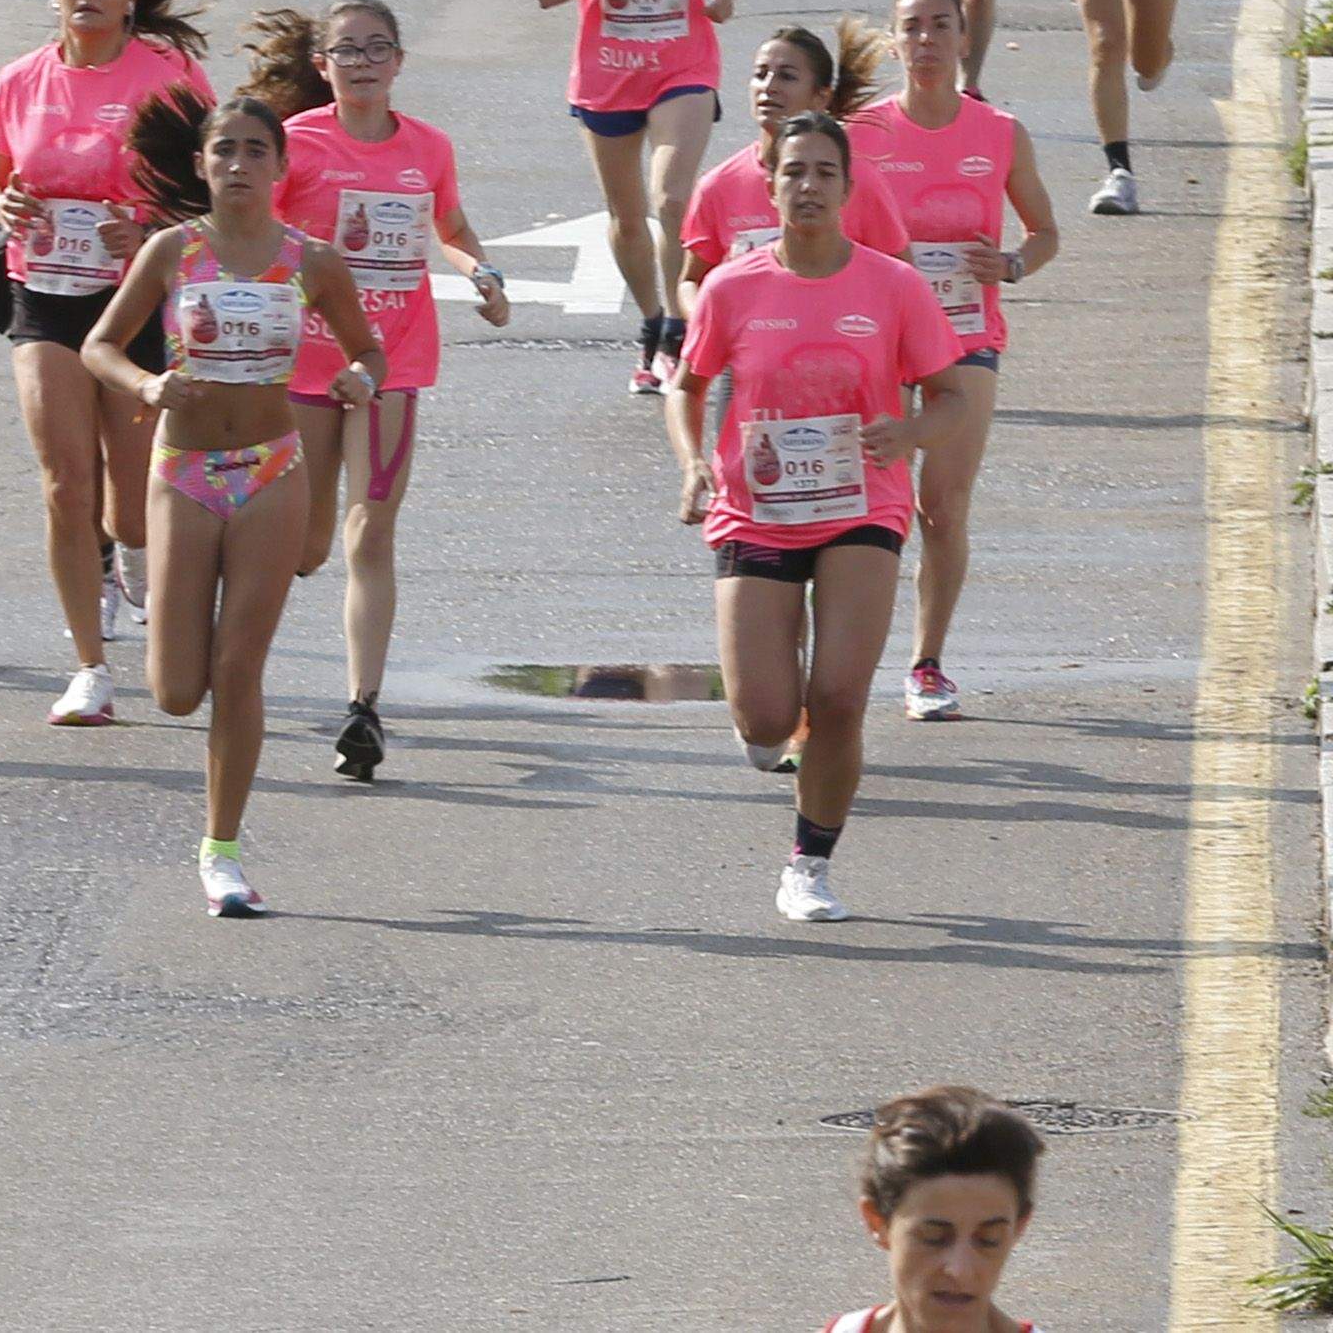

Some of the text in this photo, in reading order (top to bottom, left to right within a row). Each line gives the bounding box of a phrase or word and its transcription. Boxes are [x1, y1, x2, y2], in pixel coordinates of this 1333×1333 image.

[57, 236, 92, 253] 016
[373, 230, 408, 247] 016
[222, 321, 261, 336] 016
[785, 459, 825, 476] 016
